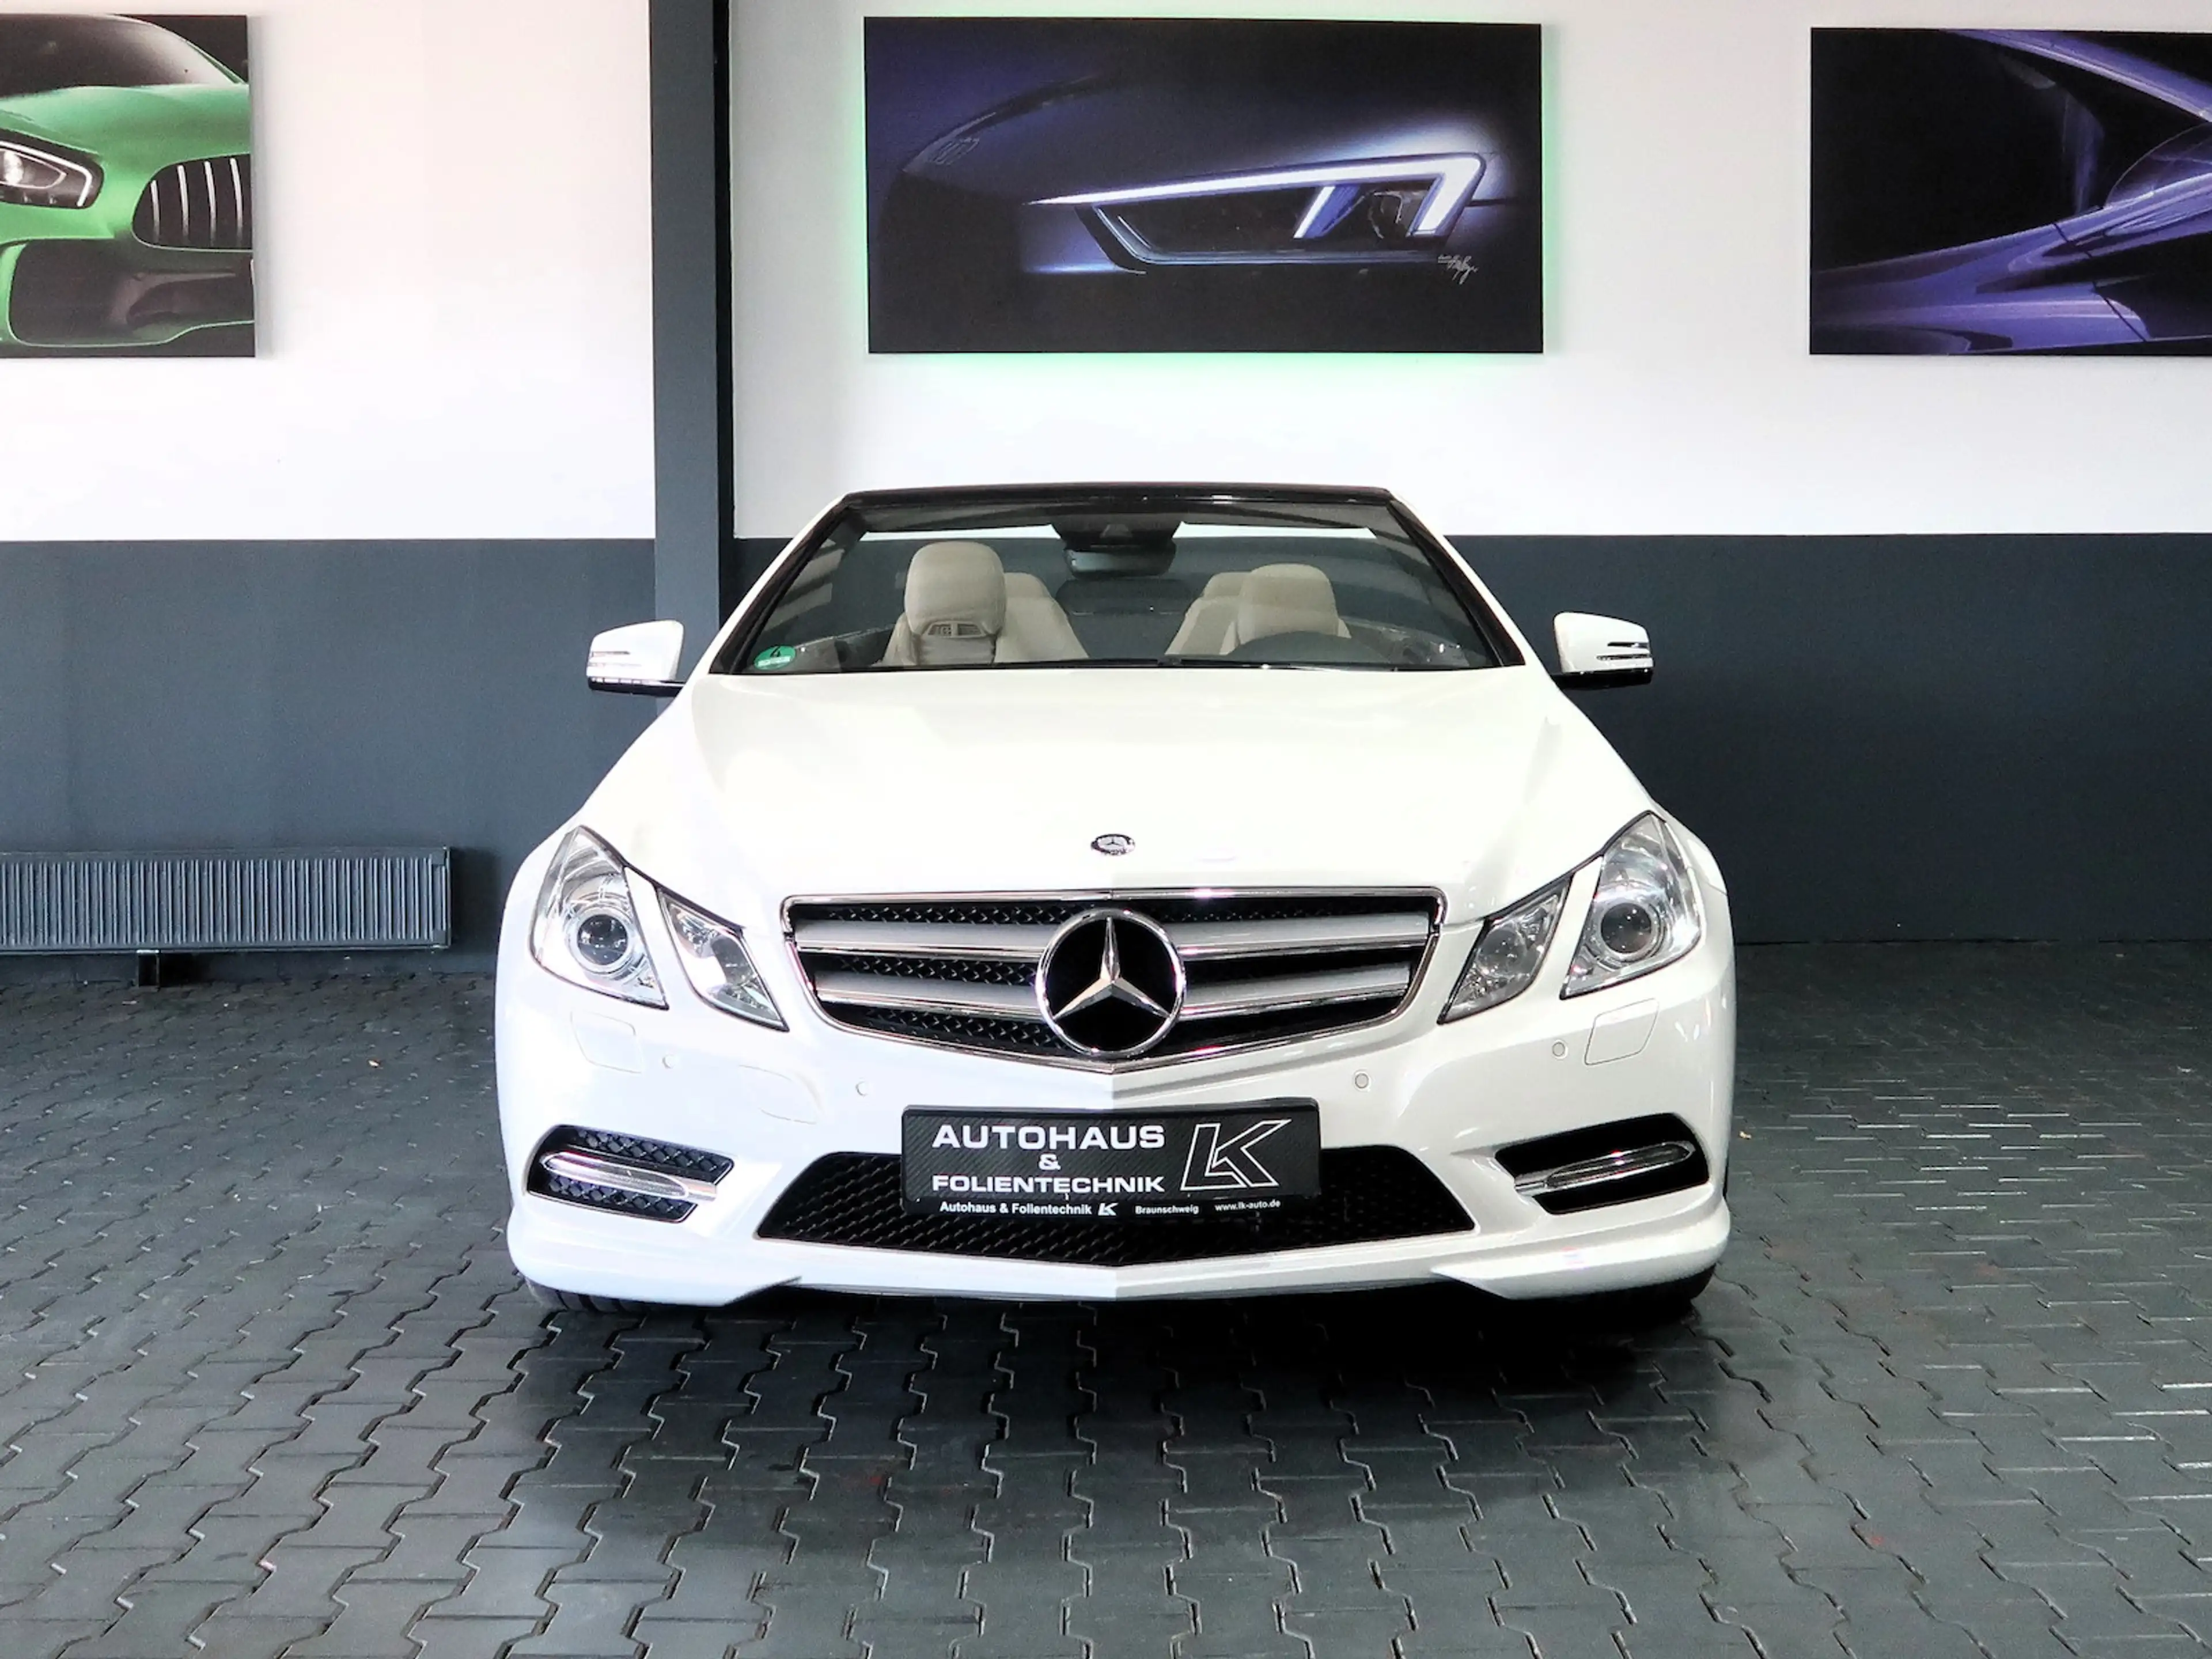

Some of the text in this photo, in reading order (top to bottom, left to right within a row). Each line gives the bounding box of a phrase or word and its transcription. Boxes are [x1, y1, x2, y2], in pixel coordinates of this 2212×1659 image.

[931, 1124, 1165, 1150] AUTOHAUS
[1038, 1153, 1062, 1171] &
[932, 1175, 1165, 1194] FOLIENTECHNIK
[940, 1200, 997, 1214] Autohaus
[999, 1202, 1009, 1214] &
[1011, 1202, 1093, 1215] Folientechnik
[1135, 1205, 1200, 1215] Braunschweig
[1214, 1199, 1281, 1211] www.lk-auto.de
